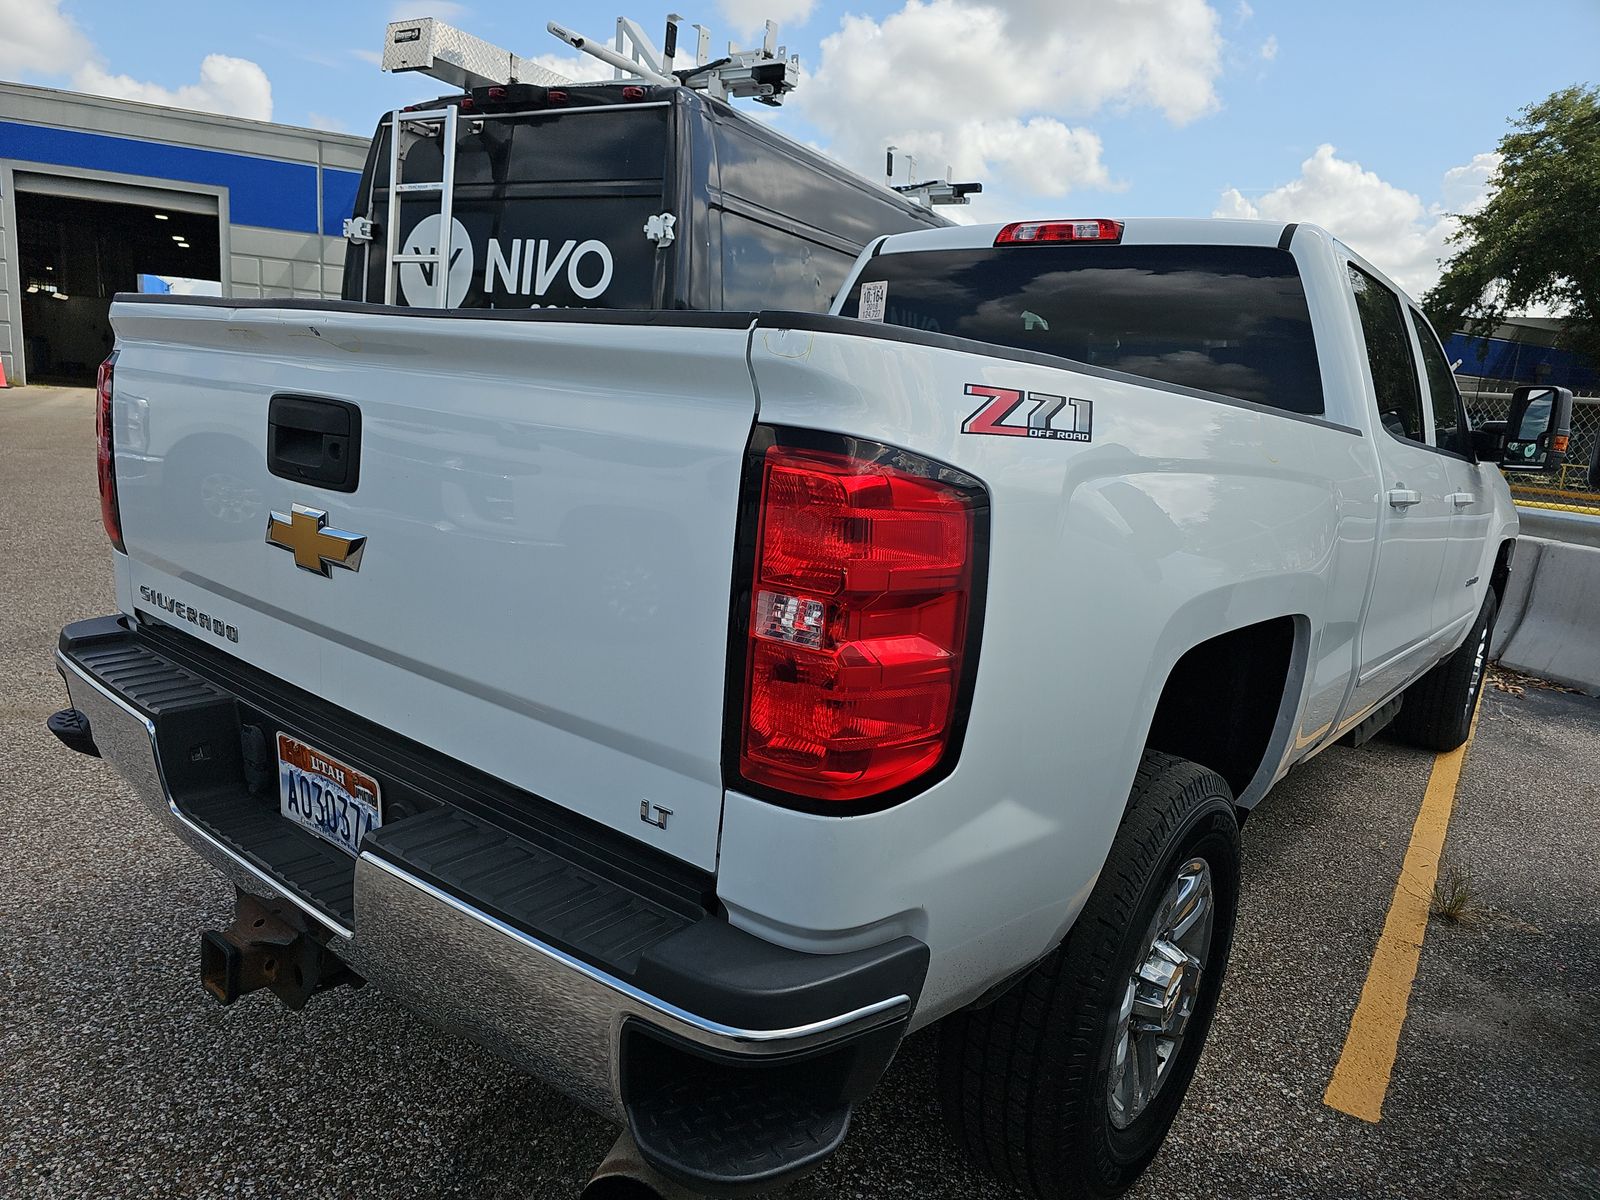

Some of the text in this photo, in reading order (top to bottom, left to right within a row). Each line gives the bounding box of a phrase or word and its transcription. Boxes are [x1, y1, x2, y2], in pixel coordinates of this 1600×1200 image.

[484, 238, 614, 300] NIVO
[961, 383, 1093, 437] Z71
[1029, 429, 1090, 441] OFF ROAD
[140, 585, 239, 643] SILVERADO
[311, 756, 346, 786] UTAH
[640, 798, 674, 831] LT
